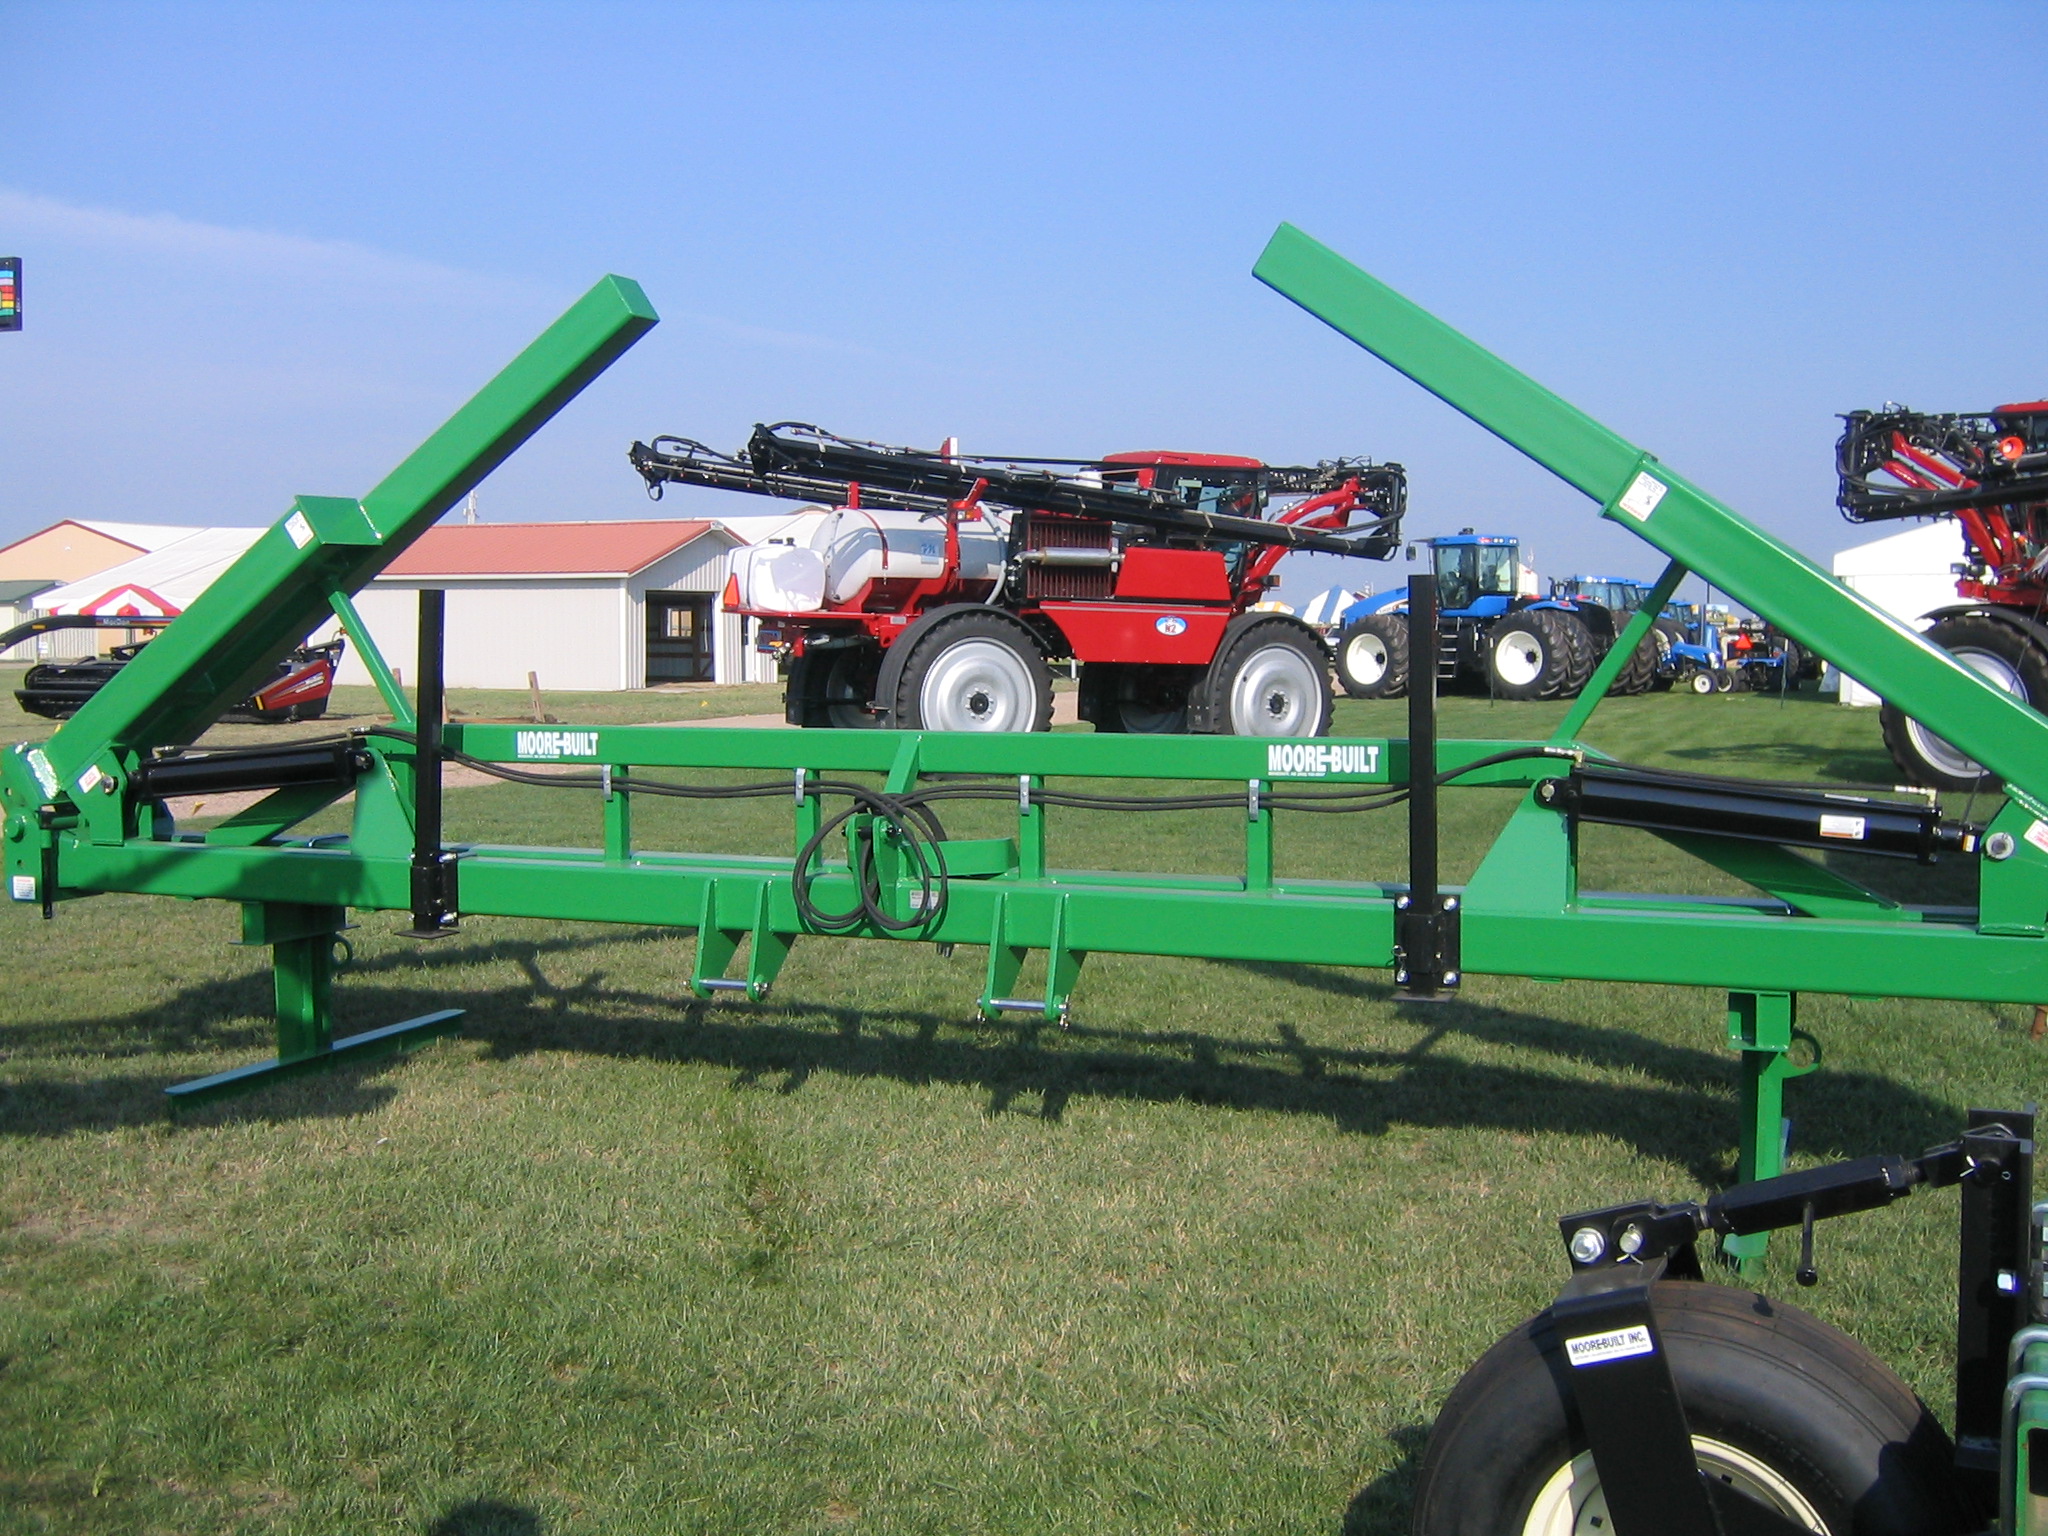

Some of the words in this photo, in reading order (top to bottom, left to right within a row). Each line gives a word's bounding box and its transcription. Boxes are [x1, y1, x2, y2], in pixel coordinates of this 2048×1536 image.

[516, 731, 599, 756] MOORE-BUILT
[1267, 744, 1380, 773] MOORE-BUILT
[1627, 1331, 1647, 1344] INC.
